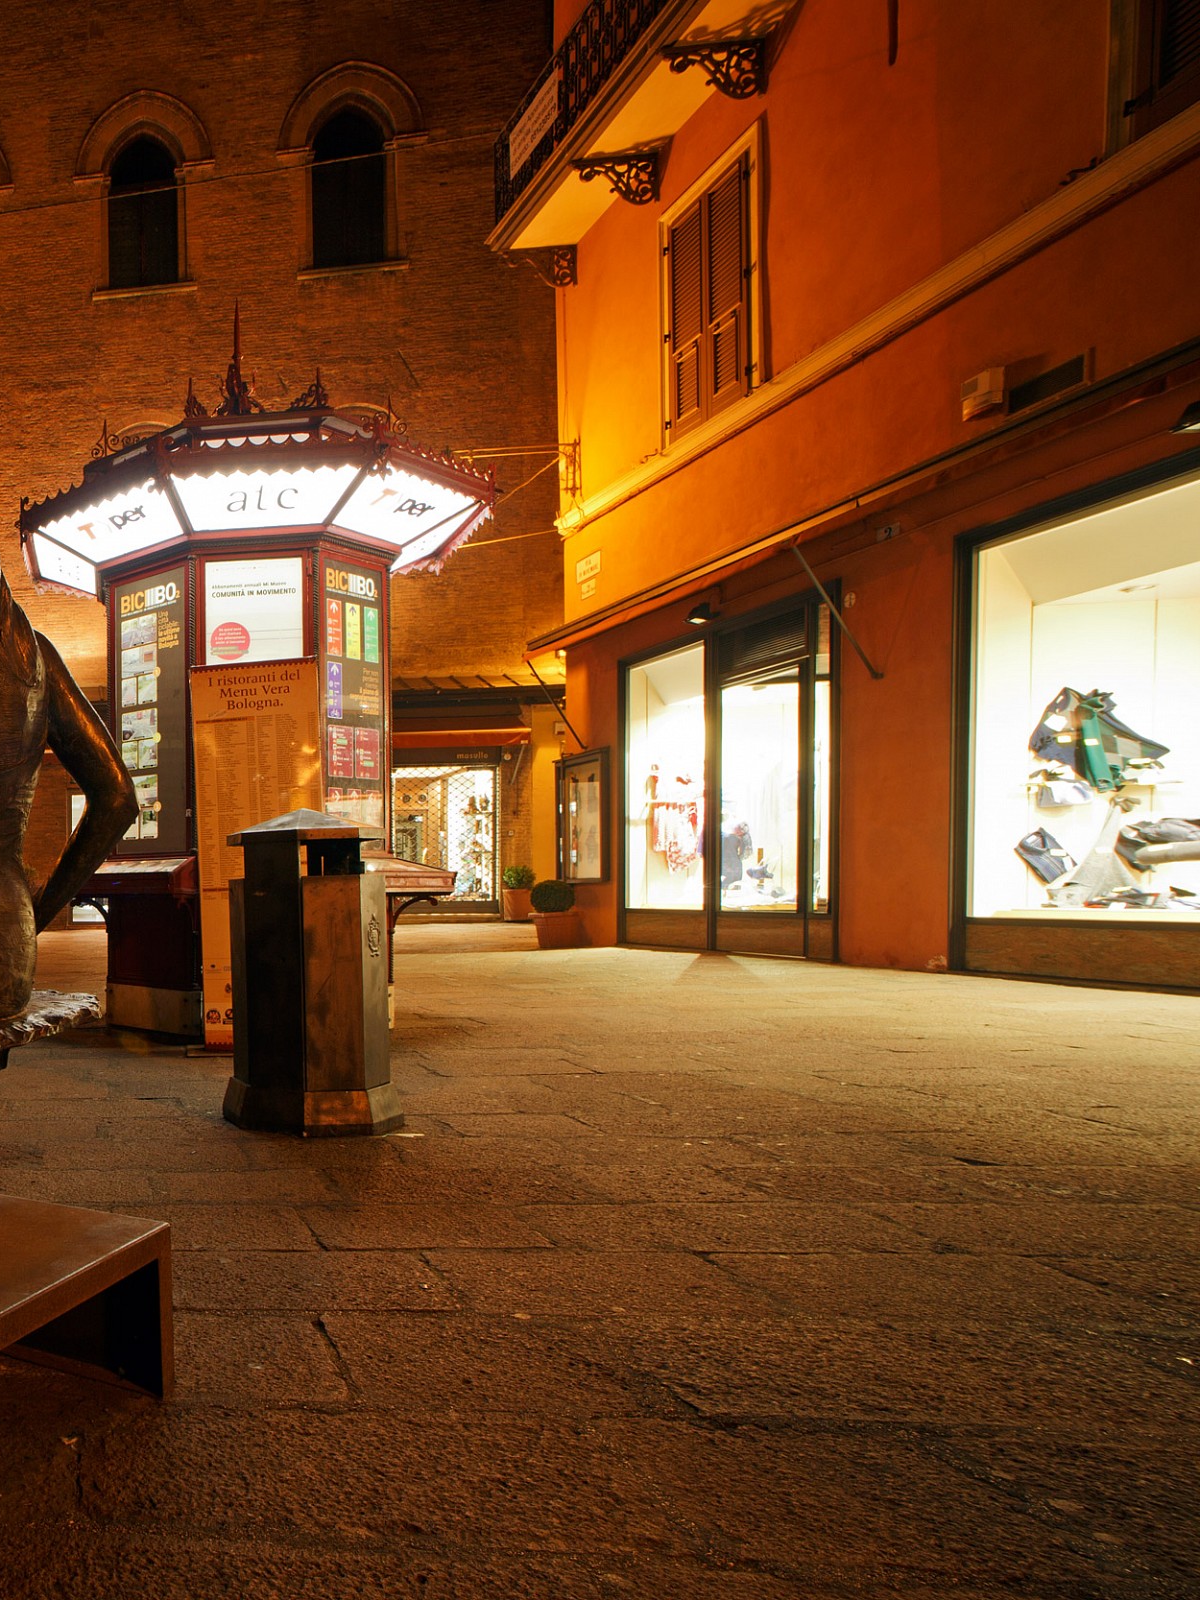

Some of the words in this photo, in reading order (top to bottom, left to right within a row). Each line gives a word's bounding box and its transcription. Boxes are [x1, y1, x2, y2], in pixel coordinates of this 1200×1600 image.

[212, 588, 246, 598] COMUNITÀ
[256, 587, 297, 597] MOVIMENTO
[208, 677, 213, 687] I
[217, 671, 276, 687] ristoranti
[280, 669, 300, 681] del
[220, 687, 257, 699] Menu
[262, 684, 290, 695] Vera
[227, 698, 284, 711] Bologna.
